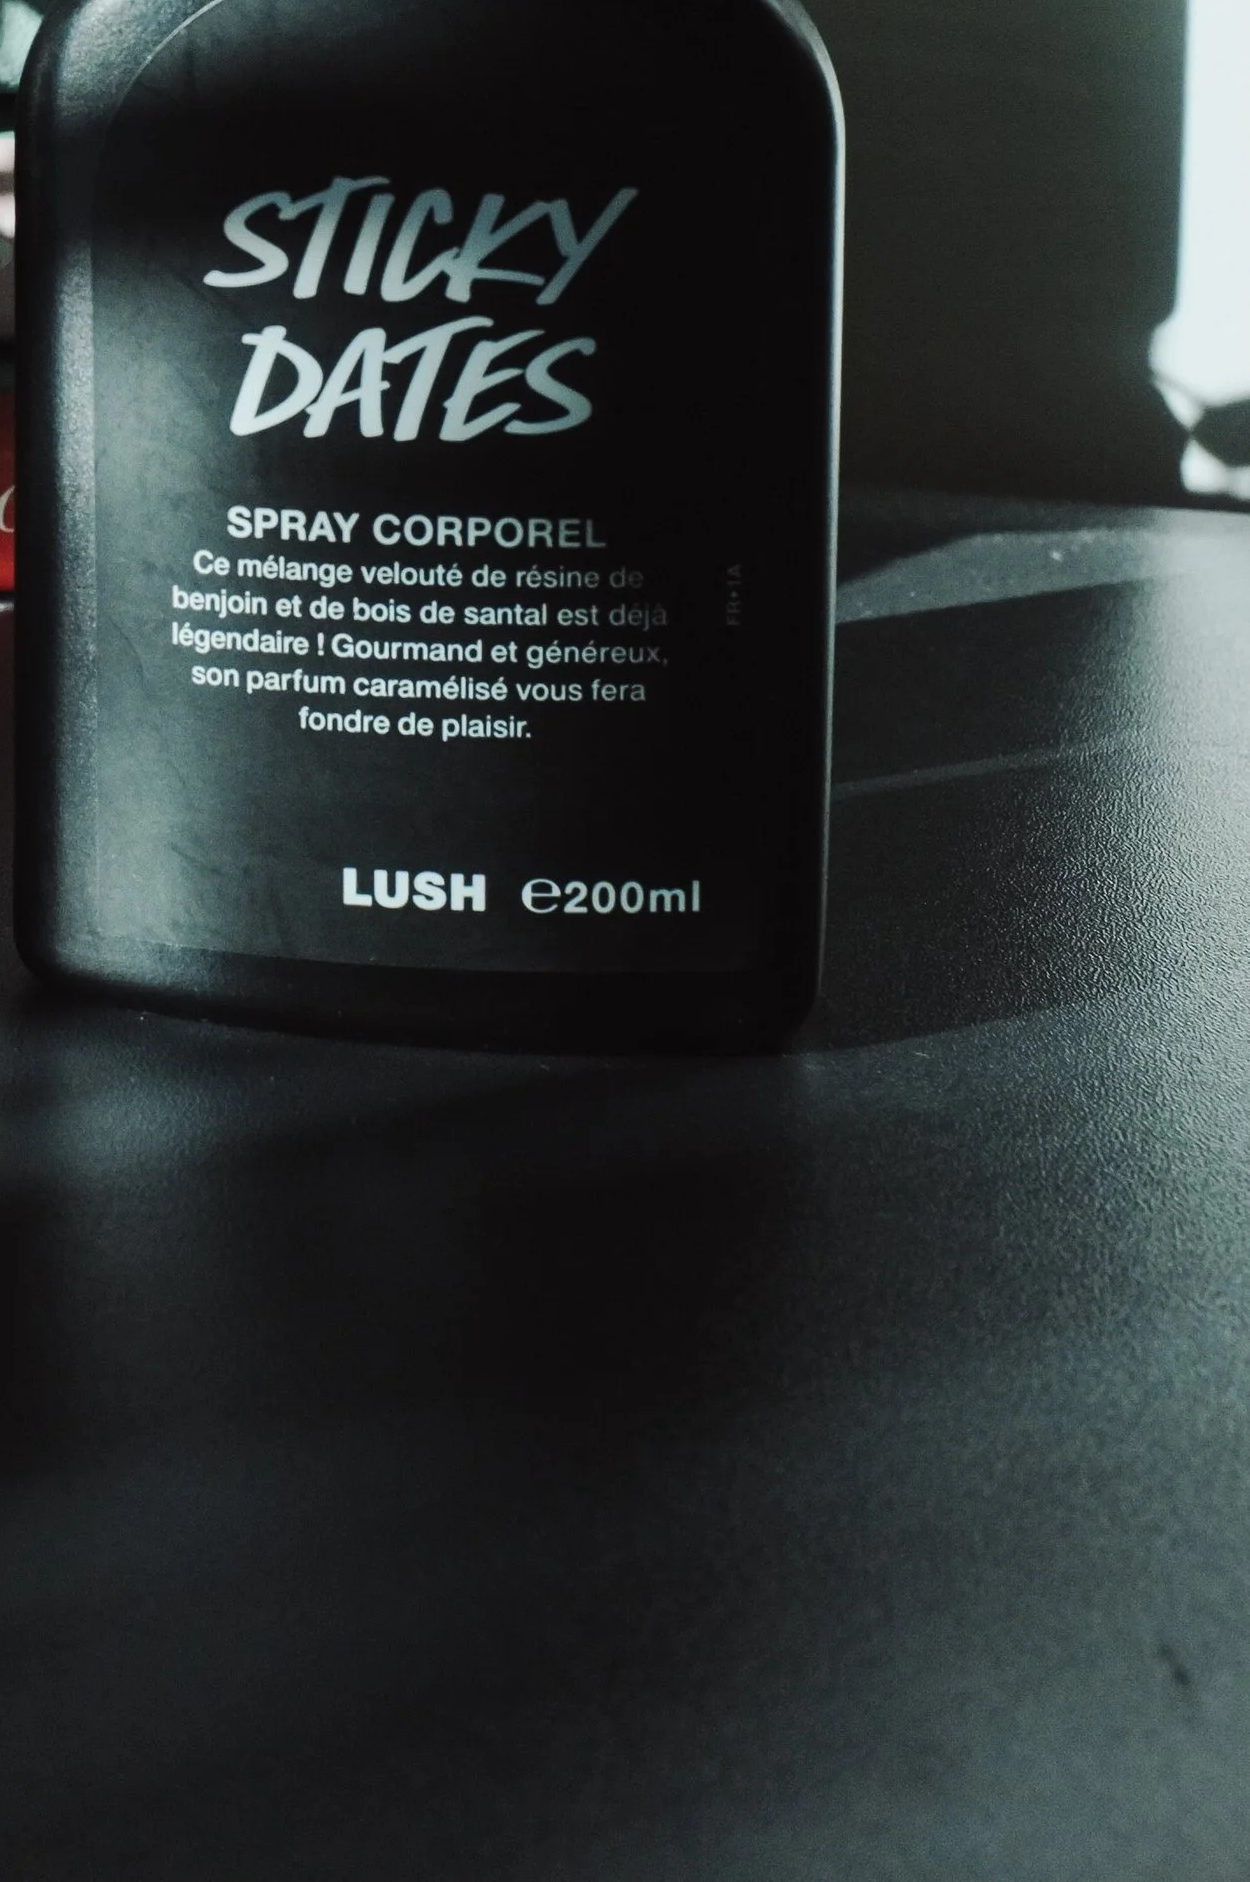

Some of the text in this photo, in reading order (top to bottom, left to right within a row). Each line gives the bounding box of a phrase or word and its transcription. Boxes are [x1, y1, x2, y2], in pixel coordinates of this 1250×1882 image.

[202, 175, 640, 306] STICKY
[229, 315, 598, 443] DATES
[226, 504, 609, 548] SPRAY CORPOREL
[192, 549, 644, 589] Ce mélange velouté de résine de
[171, 584, 668, 632] benjoin et de bois de santal est déjà
[171, 621, 310, 655] légendaire
[330, 632, 483, 662] Gourmand
[490, 640, 519, 662] et
[525, 639, 669, 670] généreux,
[191, 665, 647, 702] son parfum caramélisé vous fera
[298, 705, 532, 742] fondre de plaisir.
[342, 866, 487, 913] LUSH
